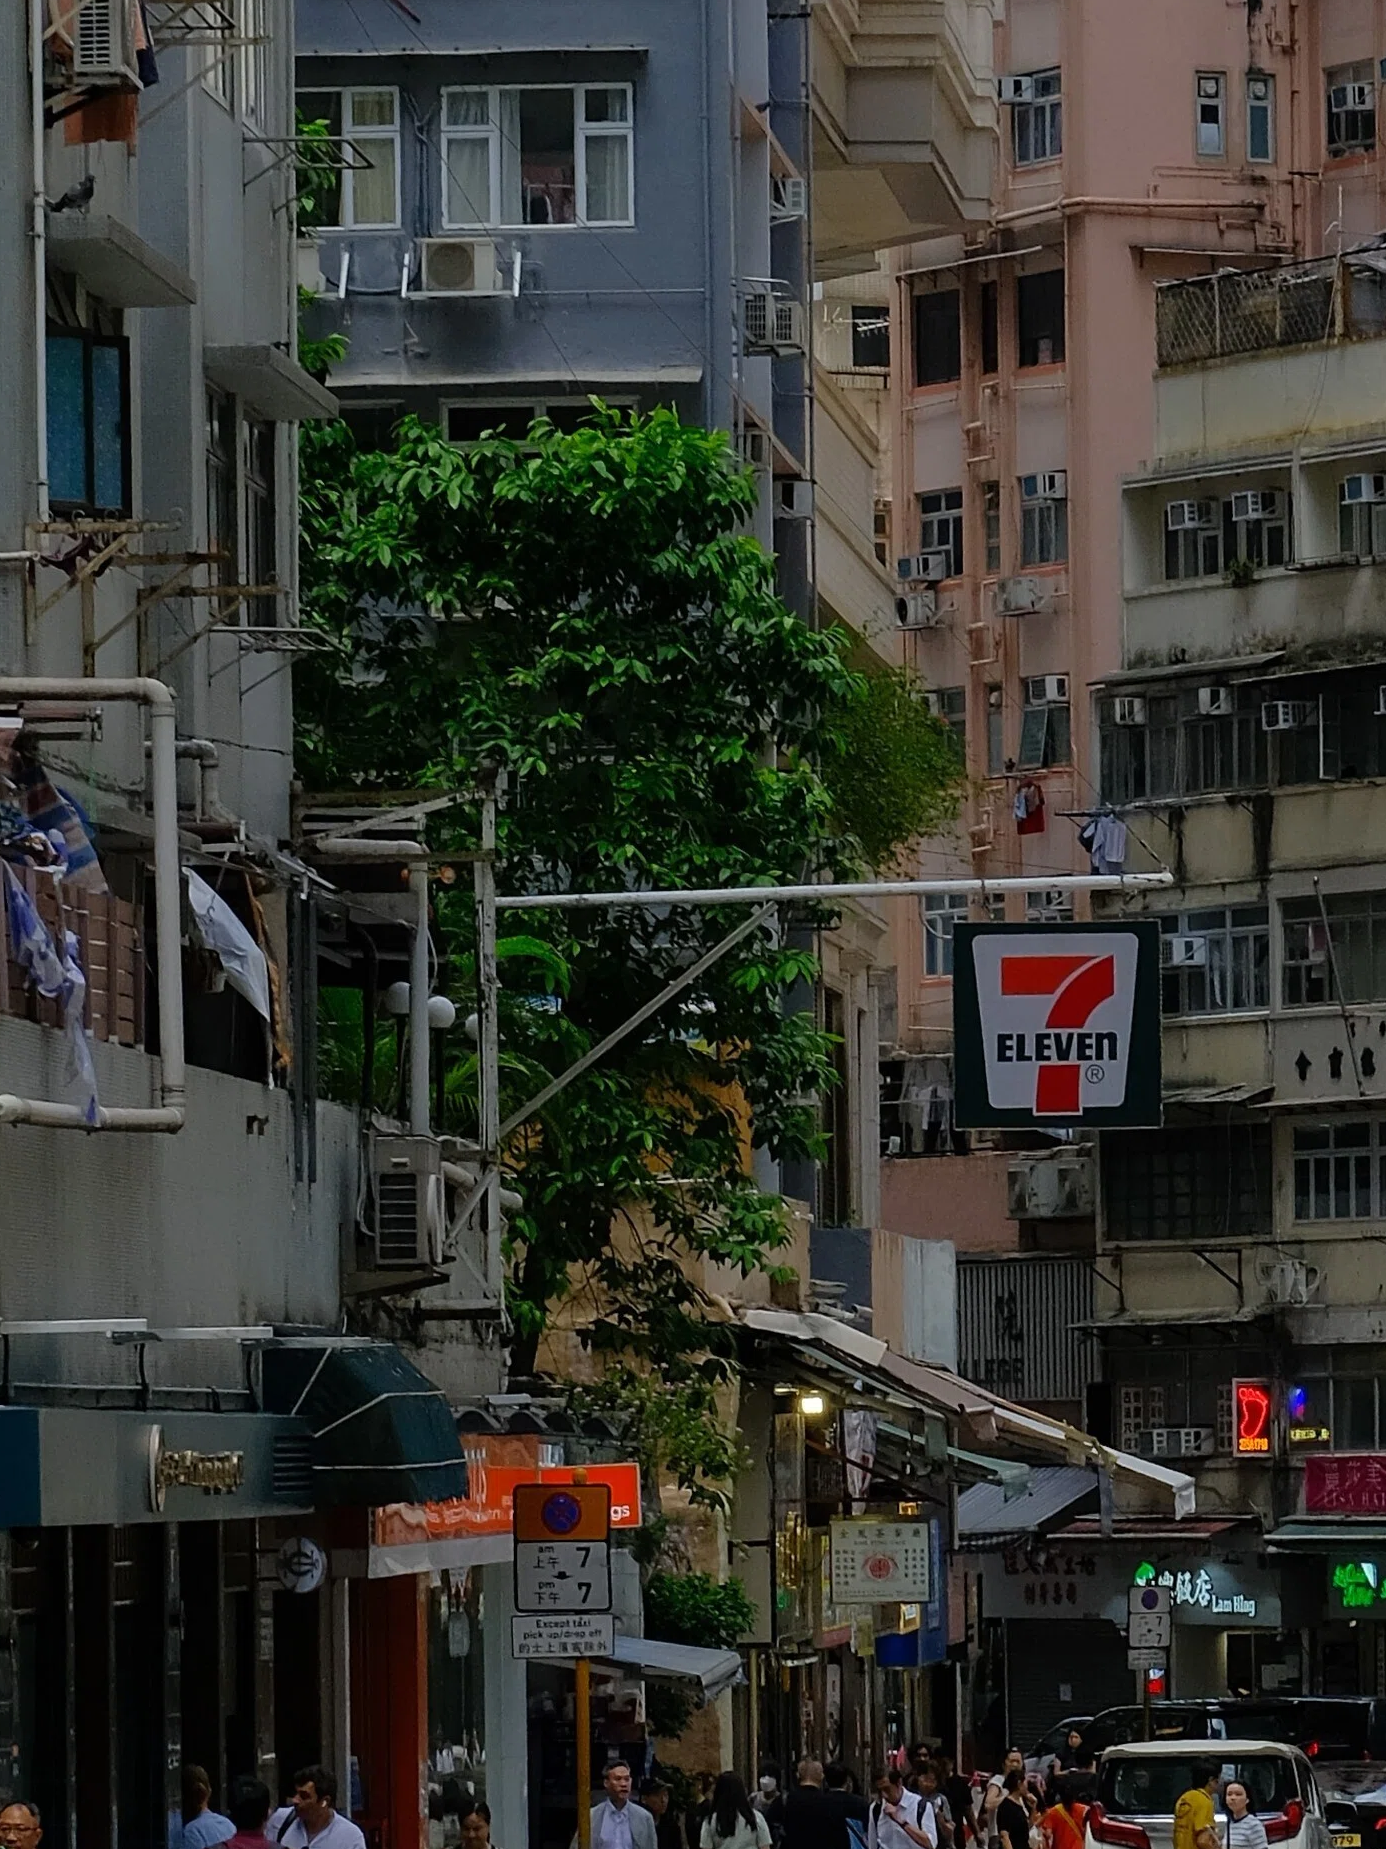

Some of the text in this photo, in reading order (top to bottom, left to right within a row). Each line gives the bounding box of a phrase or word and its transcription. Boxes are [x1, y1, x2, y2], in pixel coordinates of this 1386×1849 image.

[1001, 955, 1114, 1113] 7
[538, 1546, 555, 1554] am
[533, 1555, 560, 1569] 上午
[576, 1547, 591, 1568] 7
[538, 1581, 555, 1591] pm
[577, 1582, 592, 1603] 7
[534, 1591, 561, 1605] 下午
[536, 1617, 591, 1628] Except taxi
[523, 1629, 543, 1640] pick
